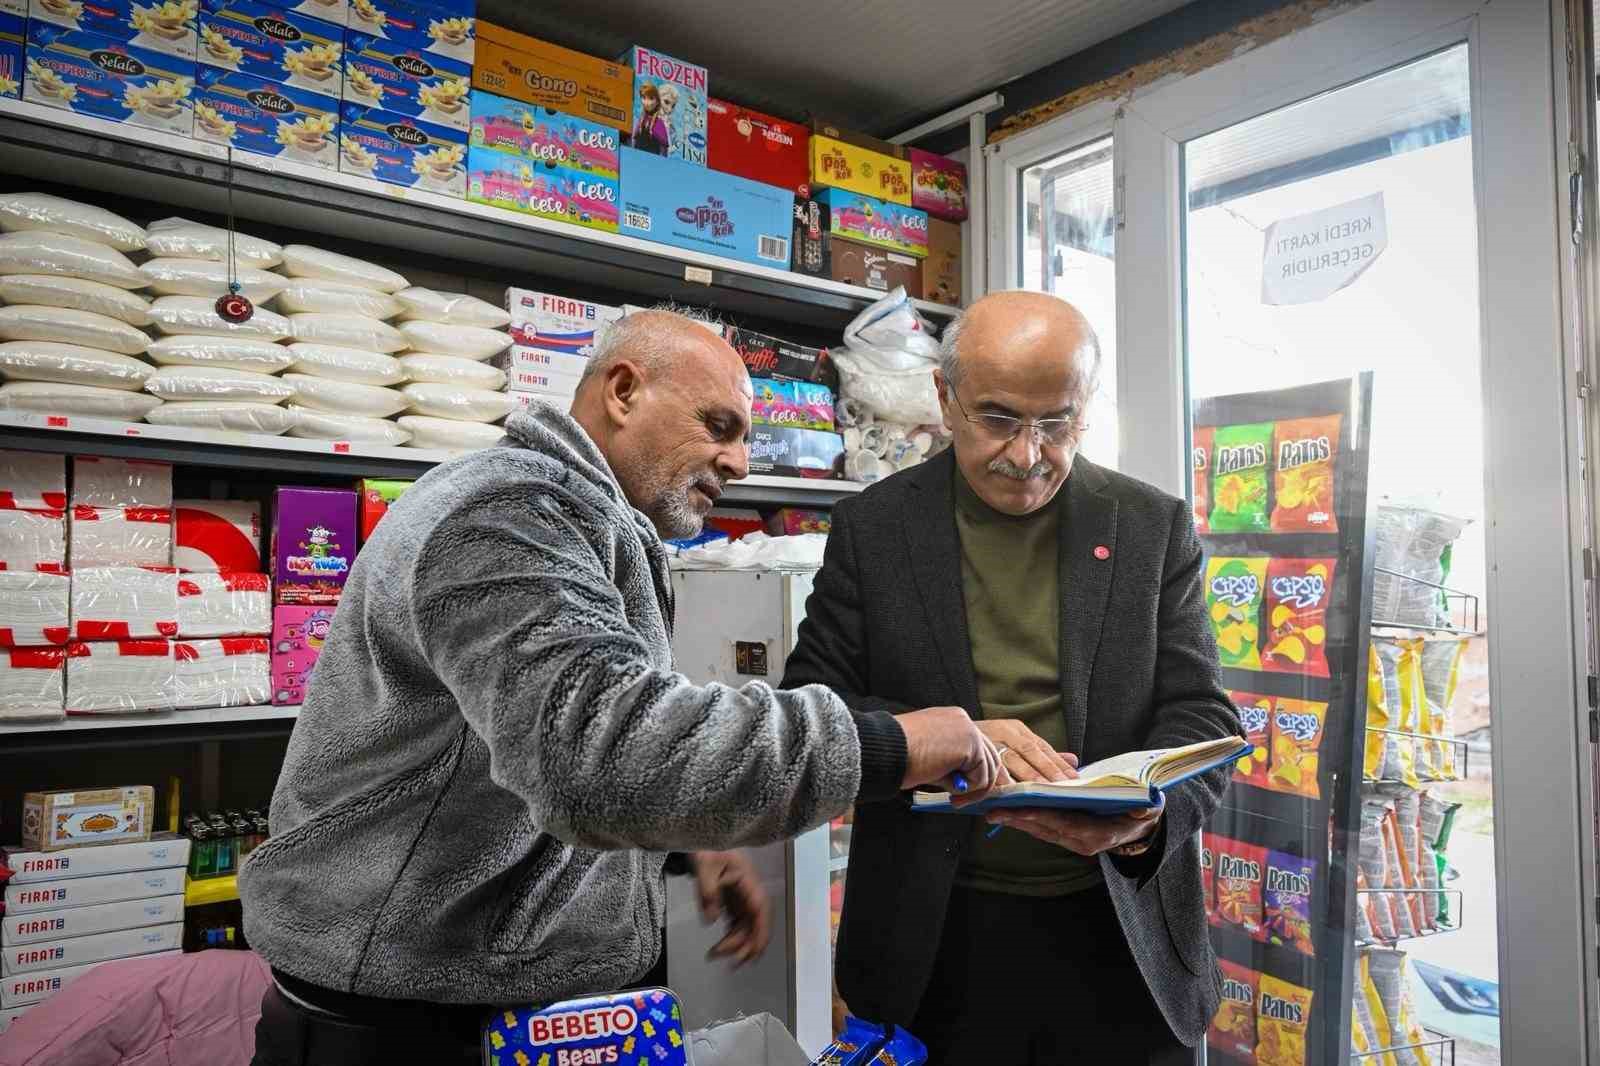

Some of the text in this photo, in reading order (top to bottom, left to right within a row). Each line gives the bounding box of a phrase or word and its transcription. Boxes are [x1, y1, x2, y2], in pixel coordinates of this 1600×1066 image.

[525, 68, 578, 97] Gong
[636, 48, 706, 91] FROZEN
[531, 1006, 635, 1044] BEBETO
[557, 1044, 618, 1066] Bears
